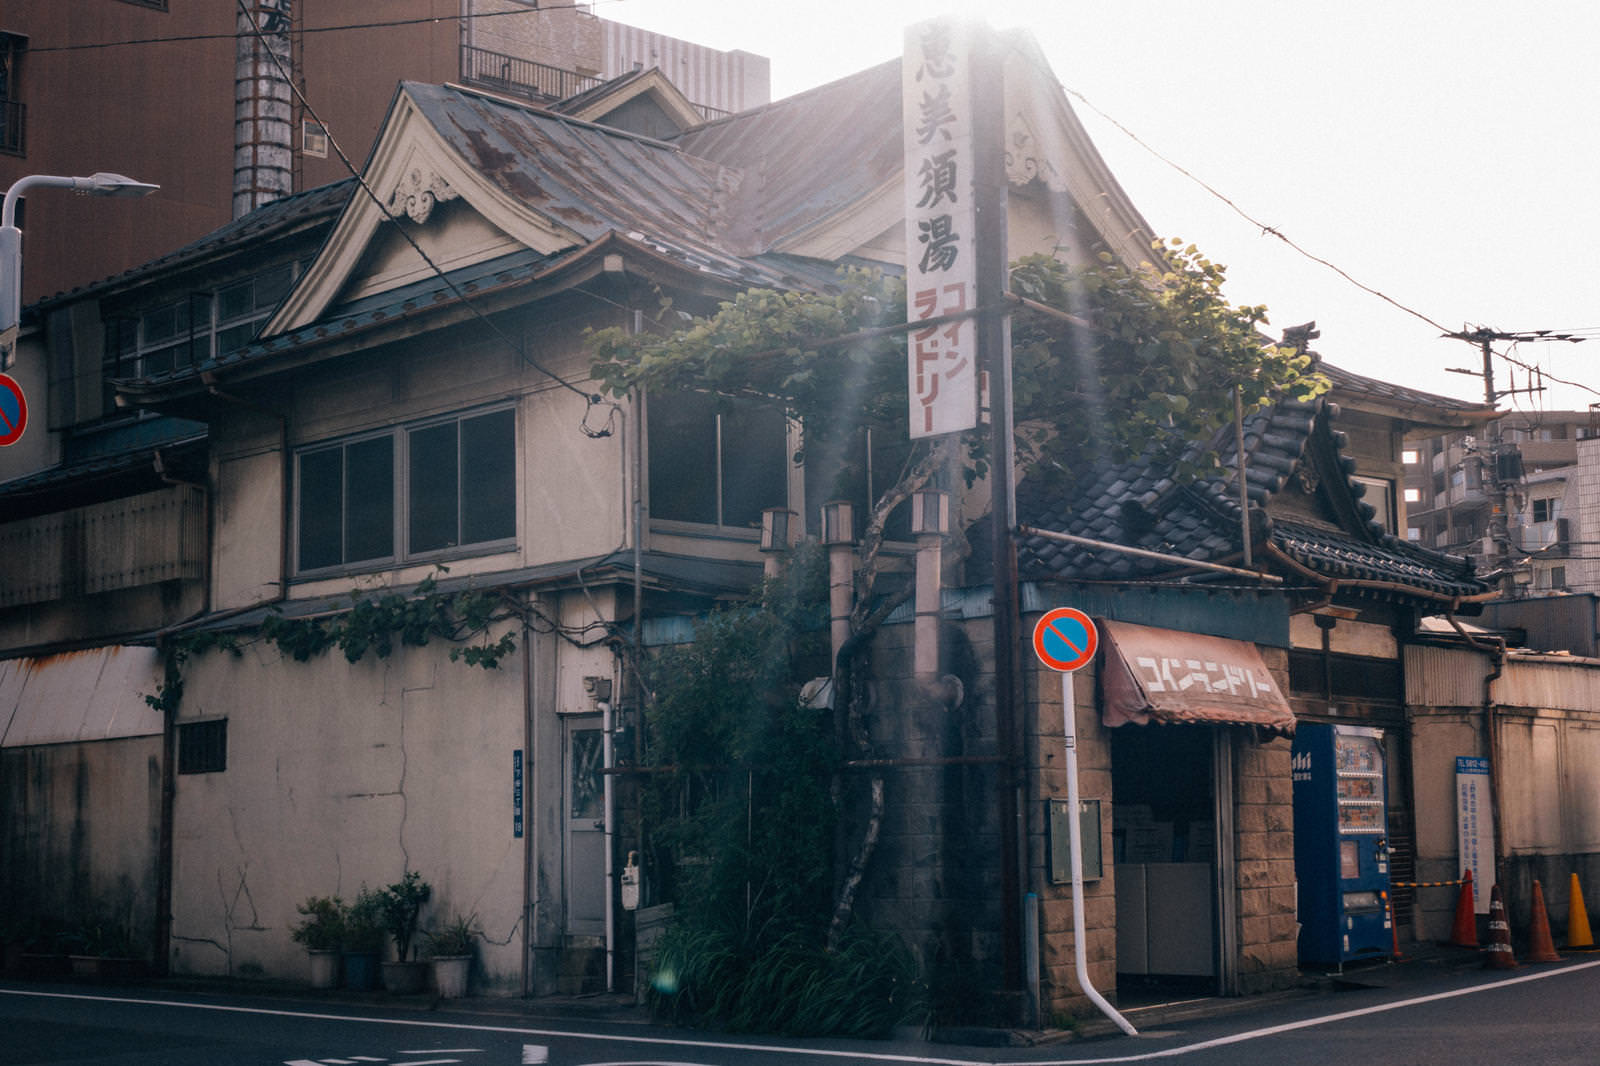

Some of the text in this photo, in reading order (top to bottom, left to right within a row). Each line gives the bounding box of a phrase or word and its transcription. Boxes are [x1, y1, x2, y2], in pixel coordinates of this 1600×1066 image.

[914, 288, 939, 432] ランドリー
[943, 281, 968, 380] コイン
[1135, 656, 1271, 699] コインランドリー
